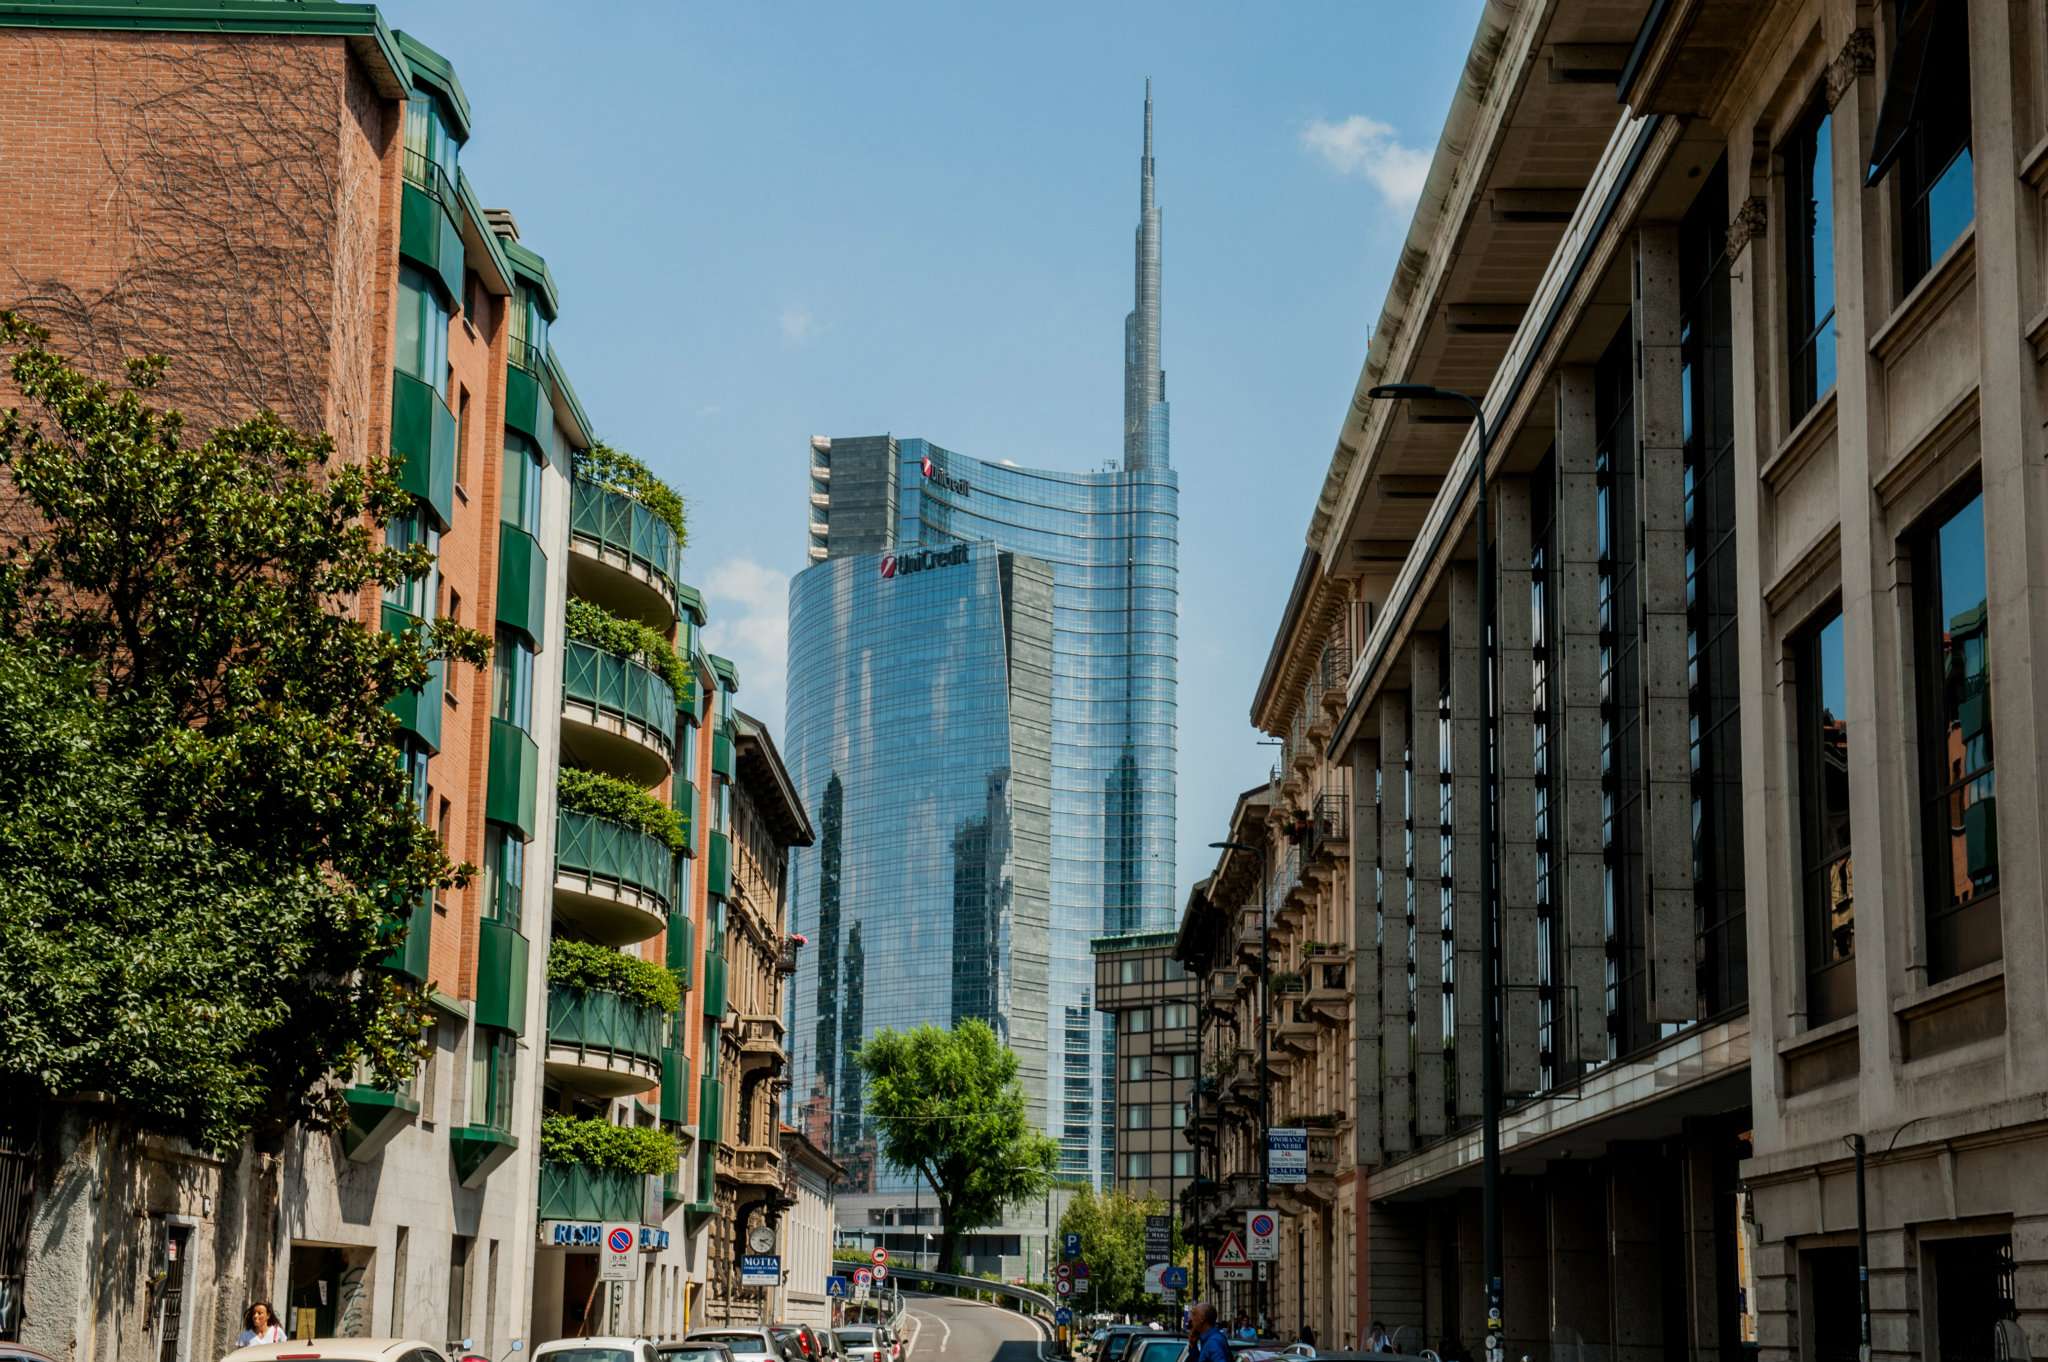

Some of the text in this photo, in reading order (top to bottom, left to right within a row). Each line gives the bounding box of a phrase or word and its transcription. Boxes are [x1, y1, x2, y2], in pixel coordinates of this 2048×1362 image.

[931, 467, 970, 497] UniCredit
[898, 544, 968, 575] UniCredit
[1067, 1235, 1077, 1247] P
[744, 1257, 778, 1266] MOTTA
[1223, 1270, 1236, 1278] 30
